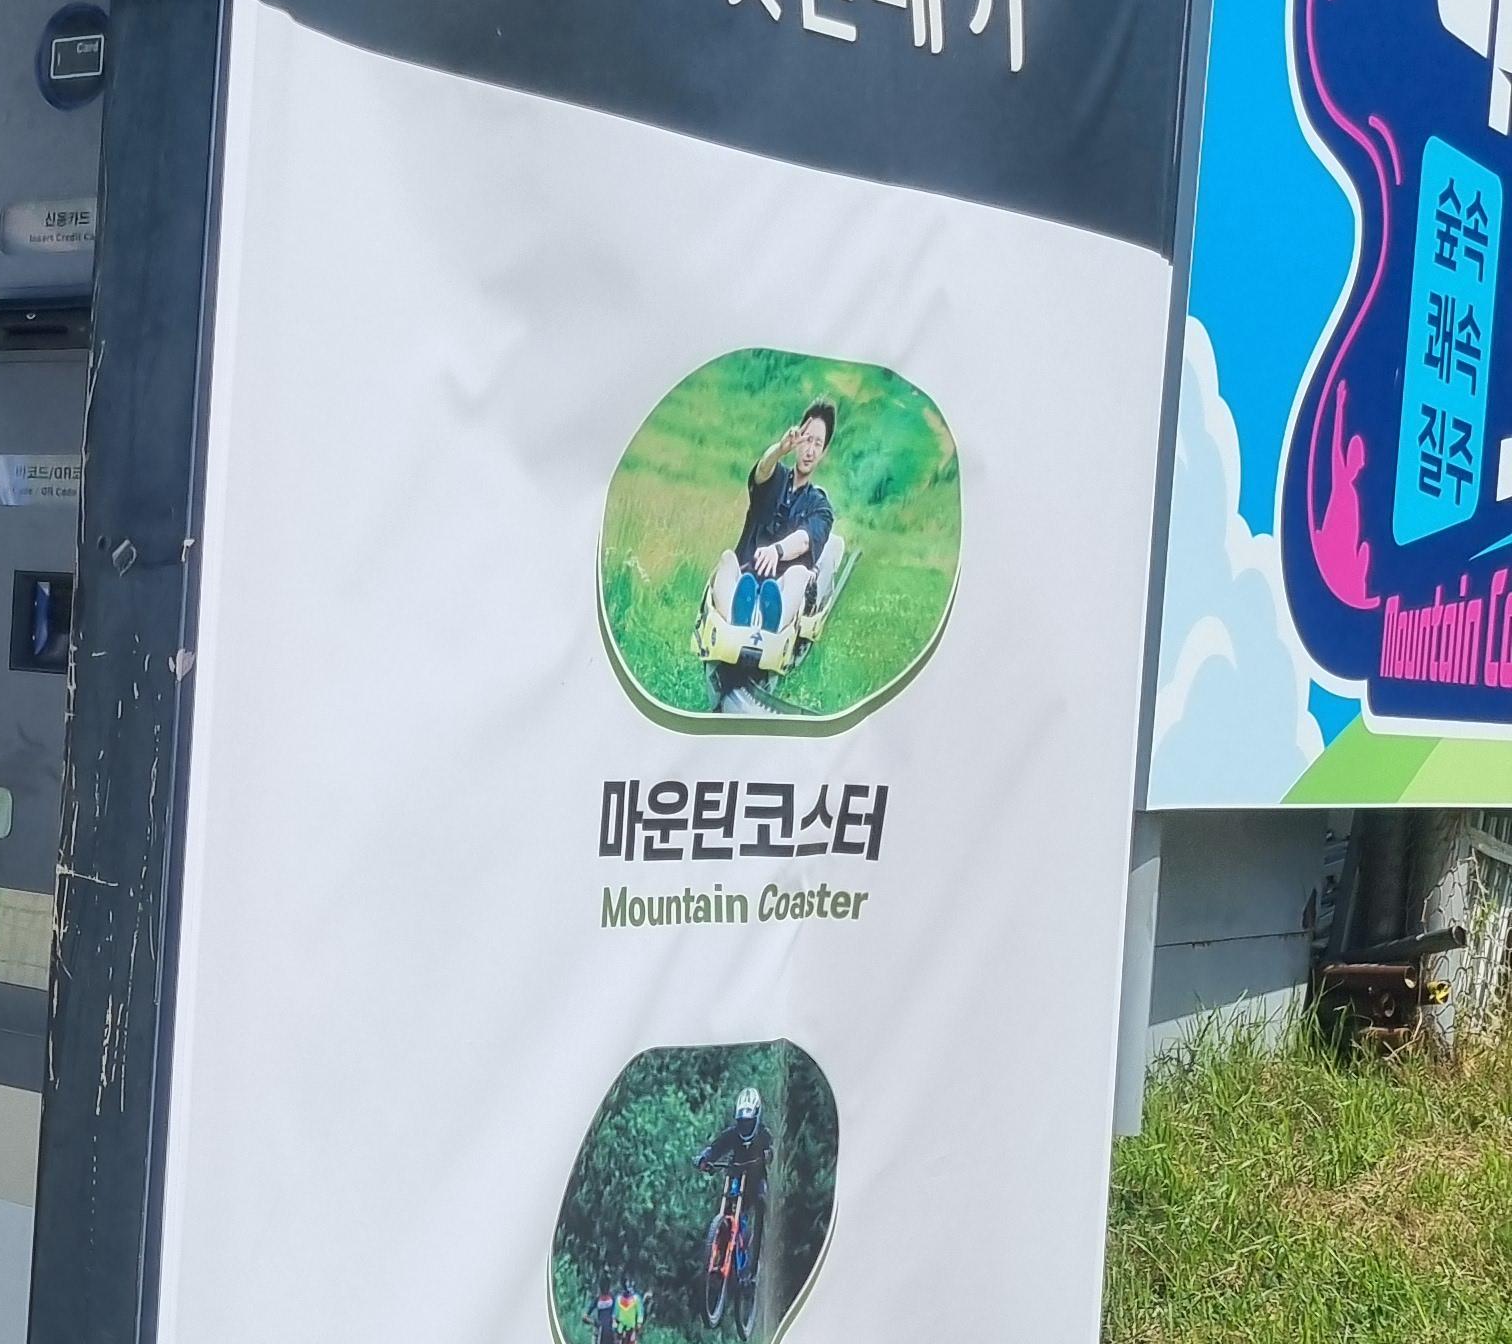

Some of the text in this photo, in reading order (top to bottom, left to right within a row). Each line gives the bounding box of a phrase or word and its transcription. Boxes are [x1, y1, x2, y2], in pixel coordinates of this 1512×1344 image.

[76, 40, 99, 54] Card
[44, 210, 90, 227] 신용카드
[1434, 177, 1489, 283] 숲속
[1424, 292, 1483, 397] 쾌속
[1417, 403, 1474, 506] 질주
[1380, 574, 1483, 686] Mountain
[598, 779, 890, 862] 마운틴코스터
[600, 882, 869, 928] Mountain Coaster
